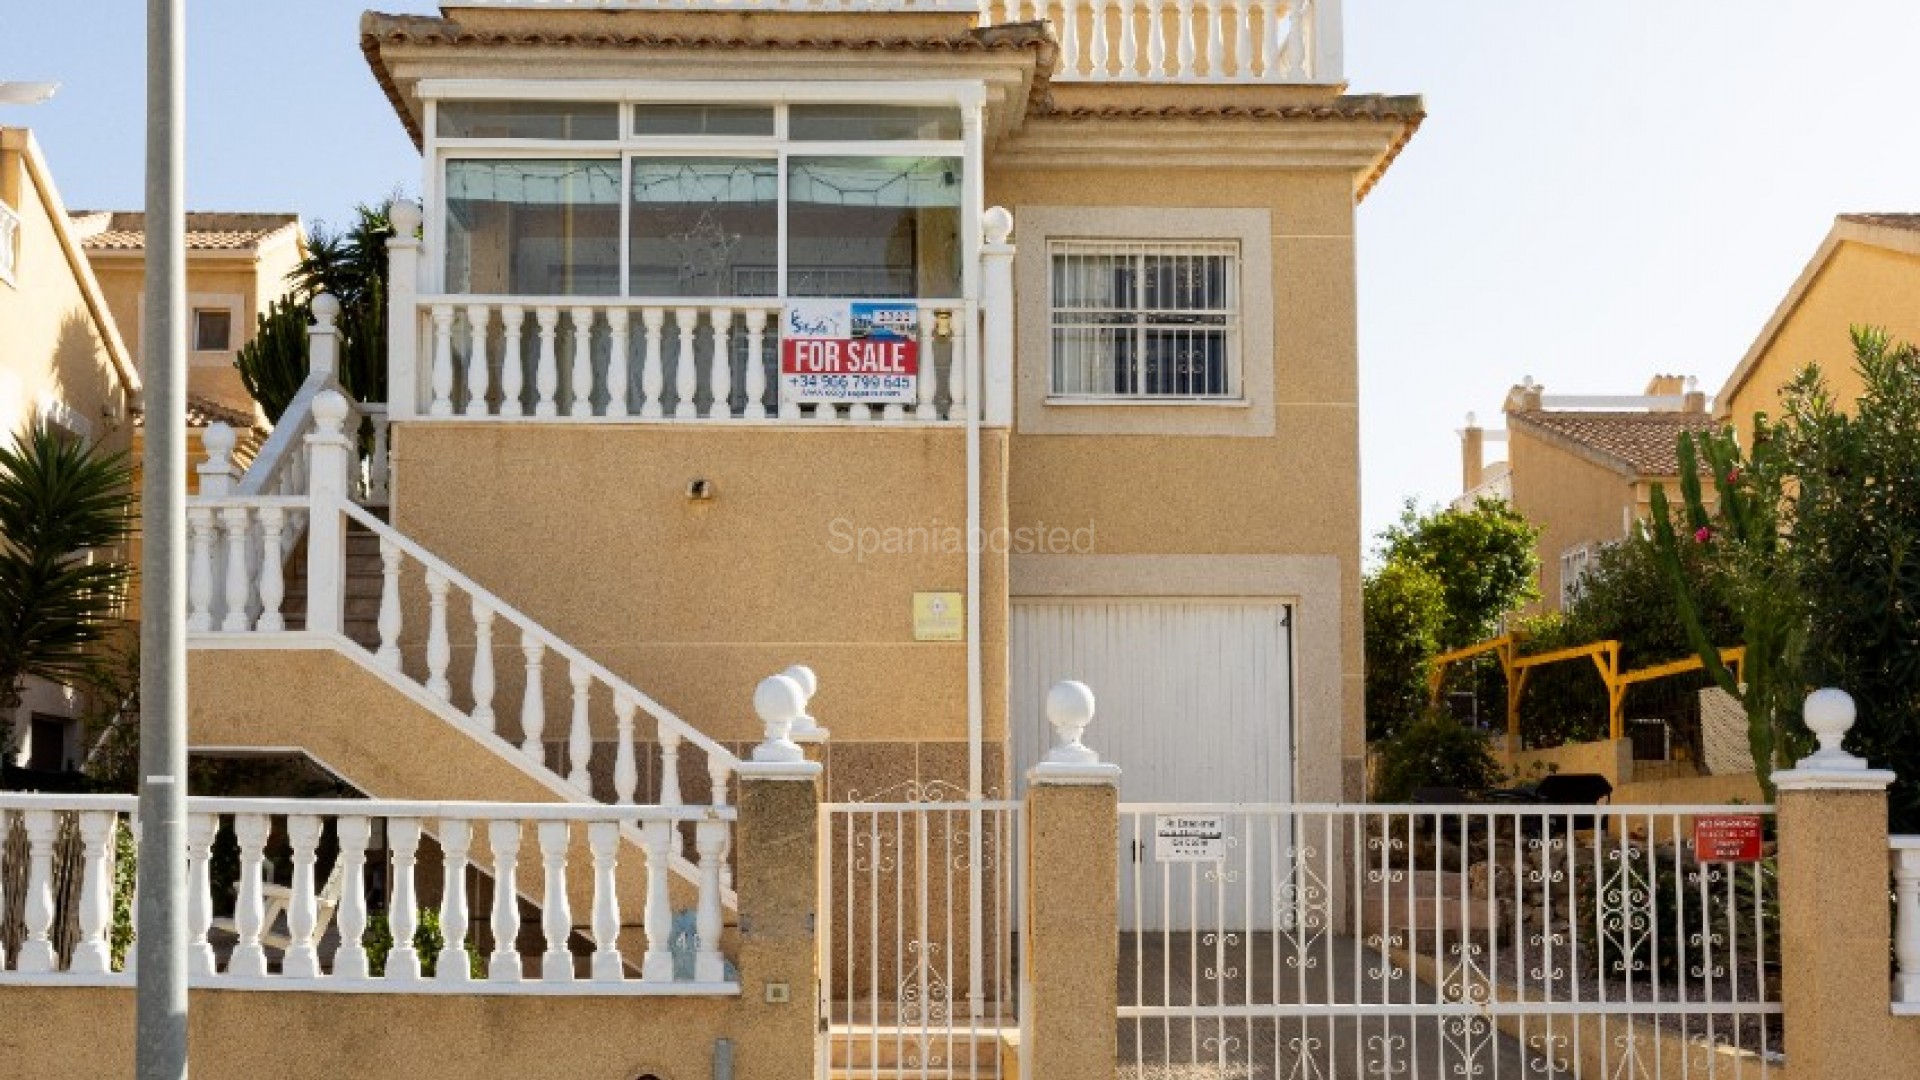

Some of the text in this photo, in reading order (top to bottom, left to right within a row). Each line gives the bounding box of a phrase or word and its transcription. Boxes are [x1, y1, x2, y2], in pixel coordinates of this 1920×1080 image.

[795, 341, 906, 372] FOR SALE
[789, 375, 818, 388] +34
[884, 375, 910, 390] 645
